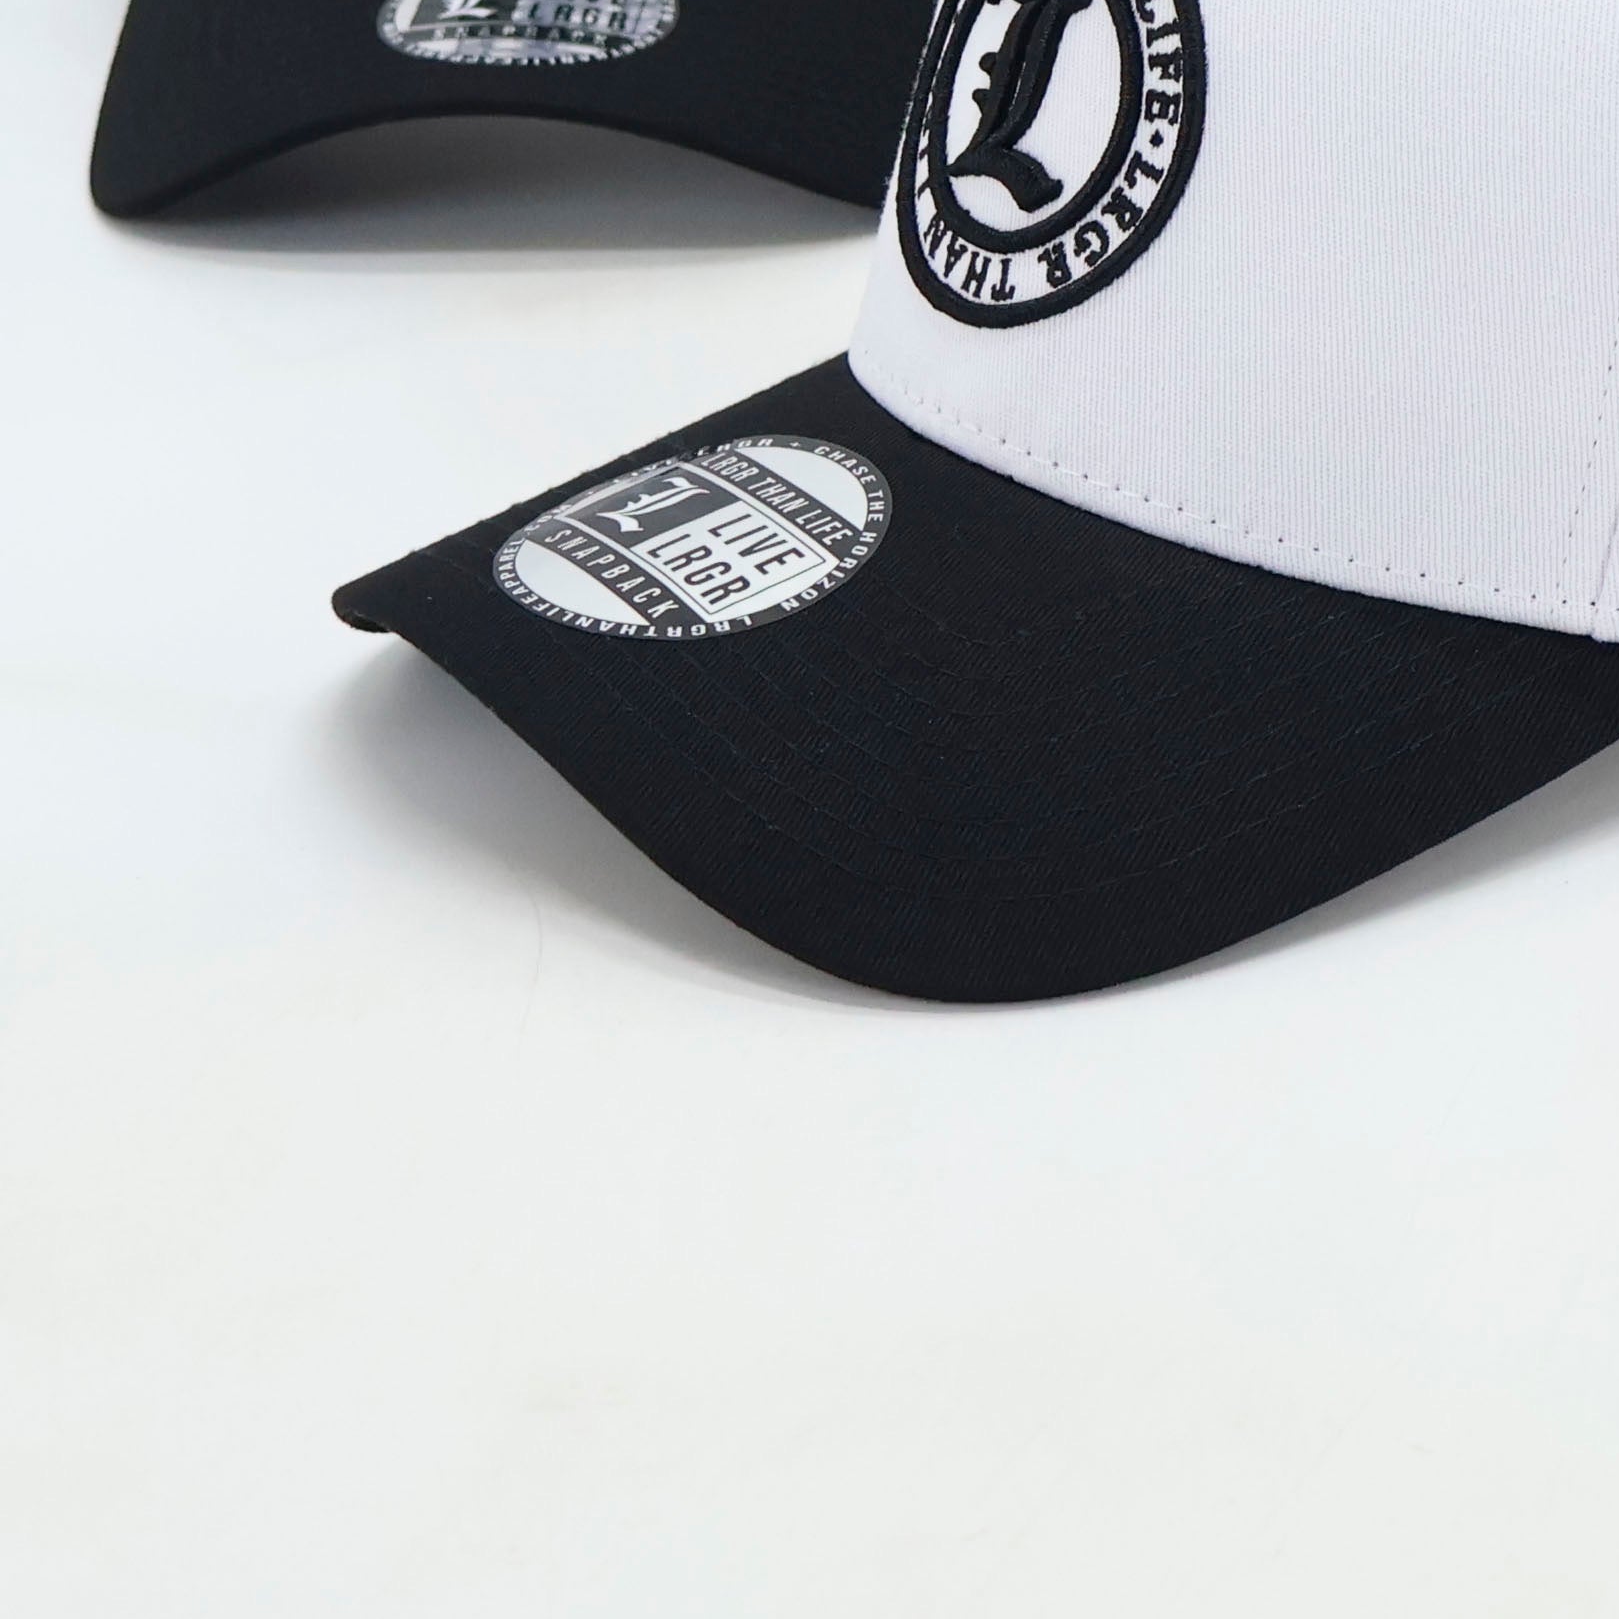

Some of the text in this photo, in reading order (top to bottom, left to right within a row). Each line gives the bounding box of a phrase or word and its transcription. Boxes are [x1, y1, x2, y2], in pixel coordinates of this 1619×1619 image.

[923, 150, 1165, 302] LRGR THAN
[701, 452, 759, 482] LRGR
[748, 477, 810, 513] THAN
[795, 509, 853, 546] LIFE
[707, 513, 806, 575] LIVE
[780, 445, 885, 612] CHASE THE HORIZON
[545, 529, 679, 619] SNAPBACK
[646, 533, 751, 605] LRGR
